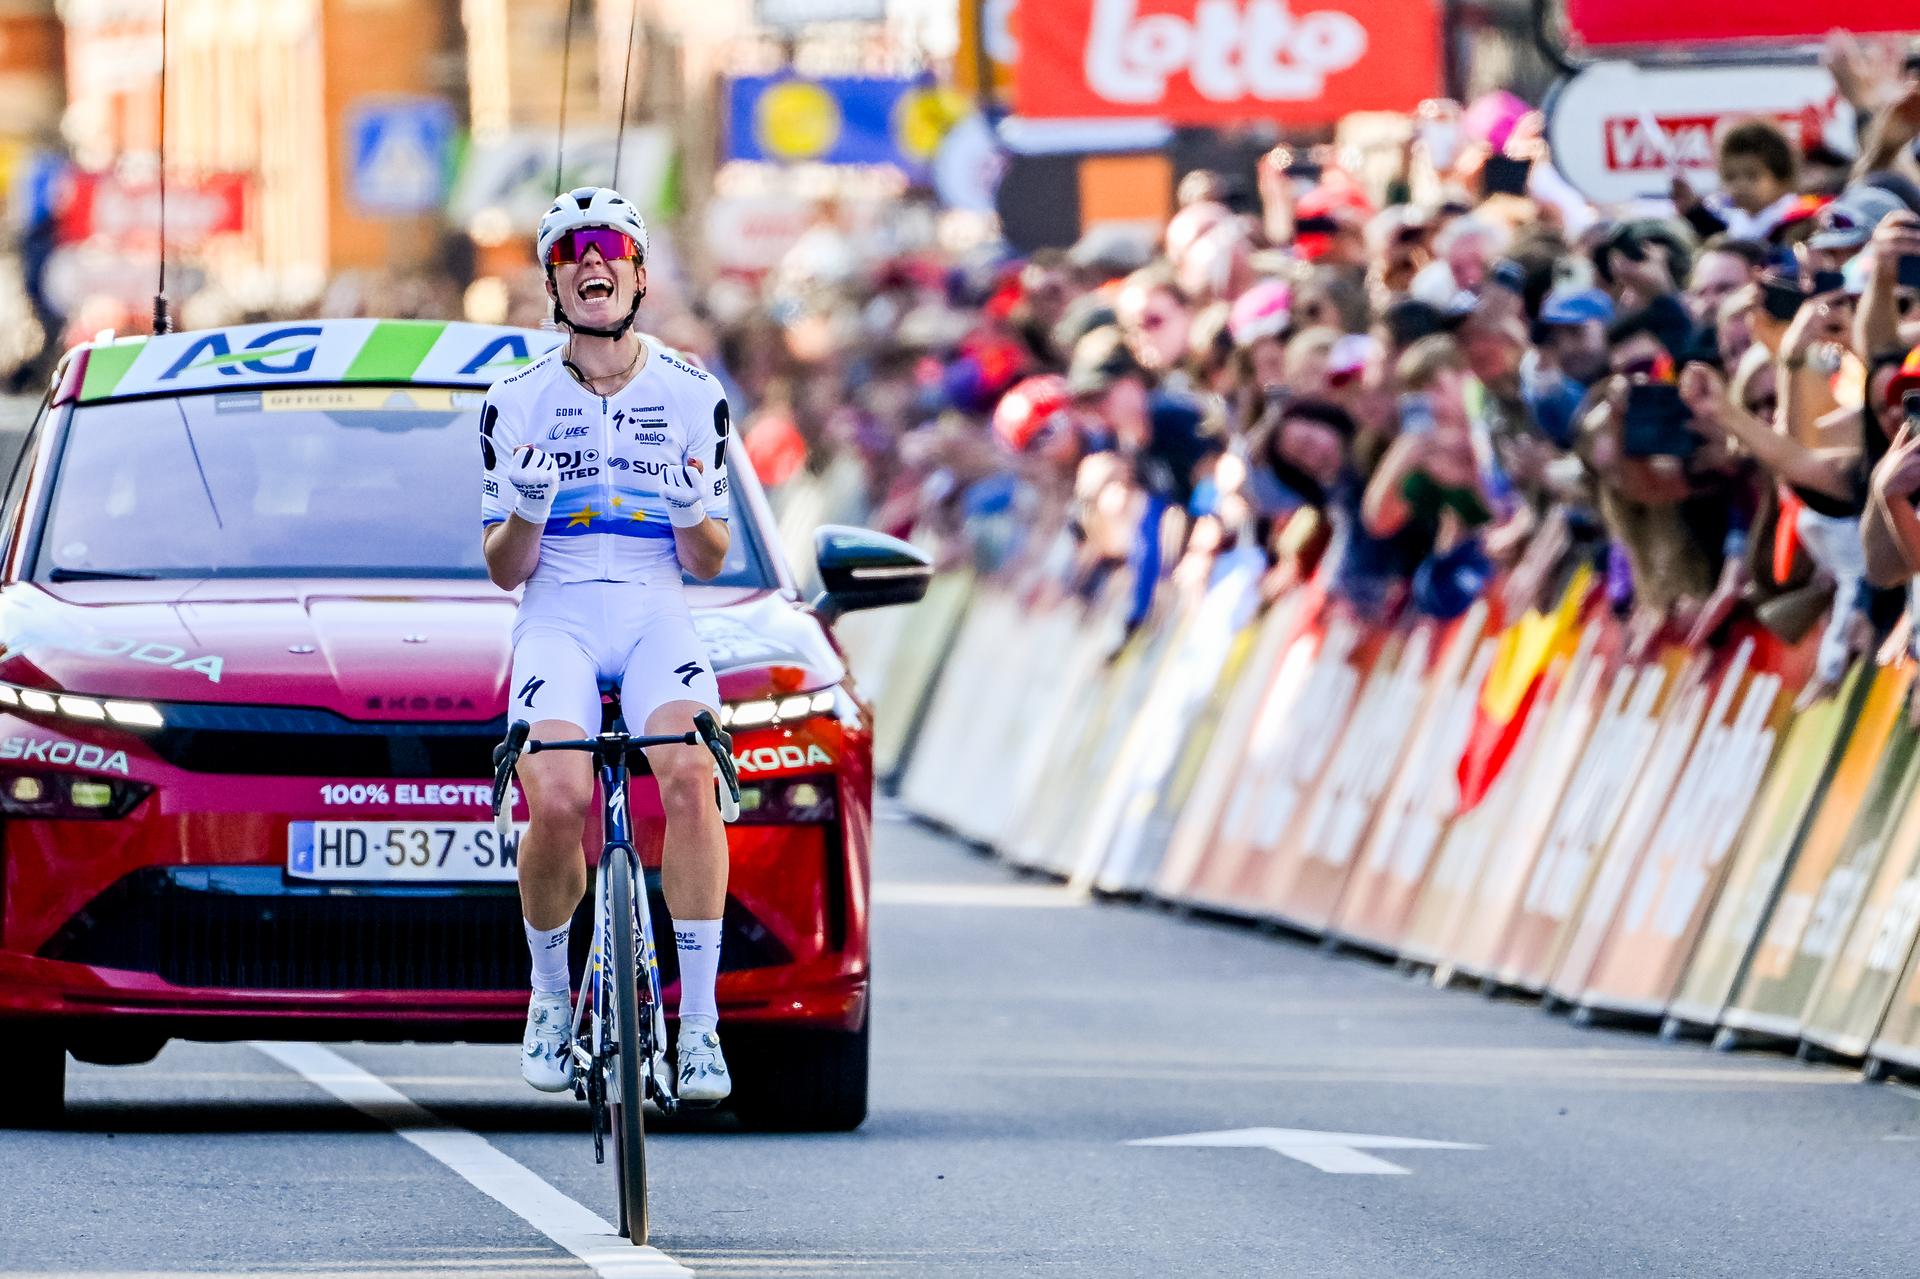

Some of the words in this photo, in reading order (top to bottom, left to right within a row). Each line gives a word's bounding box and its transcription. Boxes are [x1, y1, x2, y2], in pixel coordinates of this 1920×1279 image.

[457, 335, 548, 374] A
[503, 376, 518, 385] FDJ
[518, 360, 546, 379] UNITED
[555, 407, 583, 417] GOBIK
[565, 426, 590, 435] UEC
[551, 450, 581, 470] DJ
[560, 467, 600, 482] ITED
[714, 744, 832, 774] KODA
[320, 784, 390, 805] 100%
[395, 784, 520, 805] ELECTR
